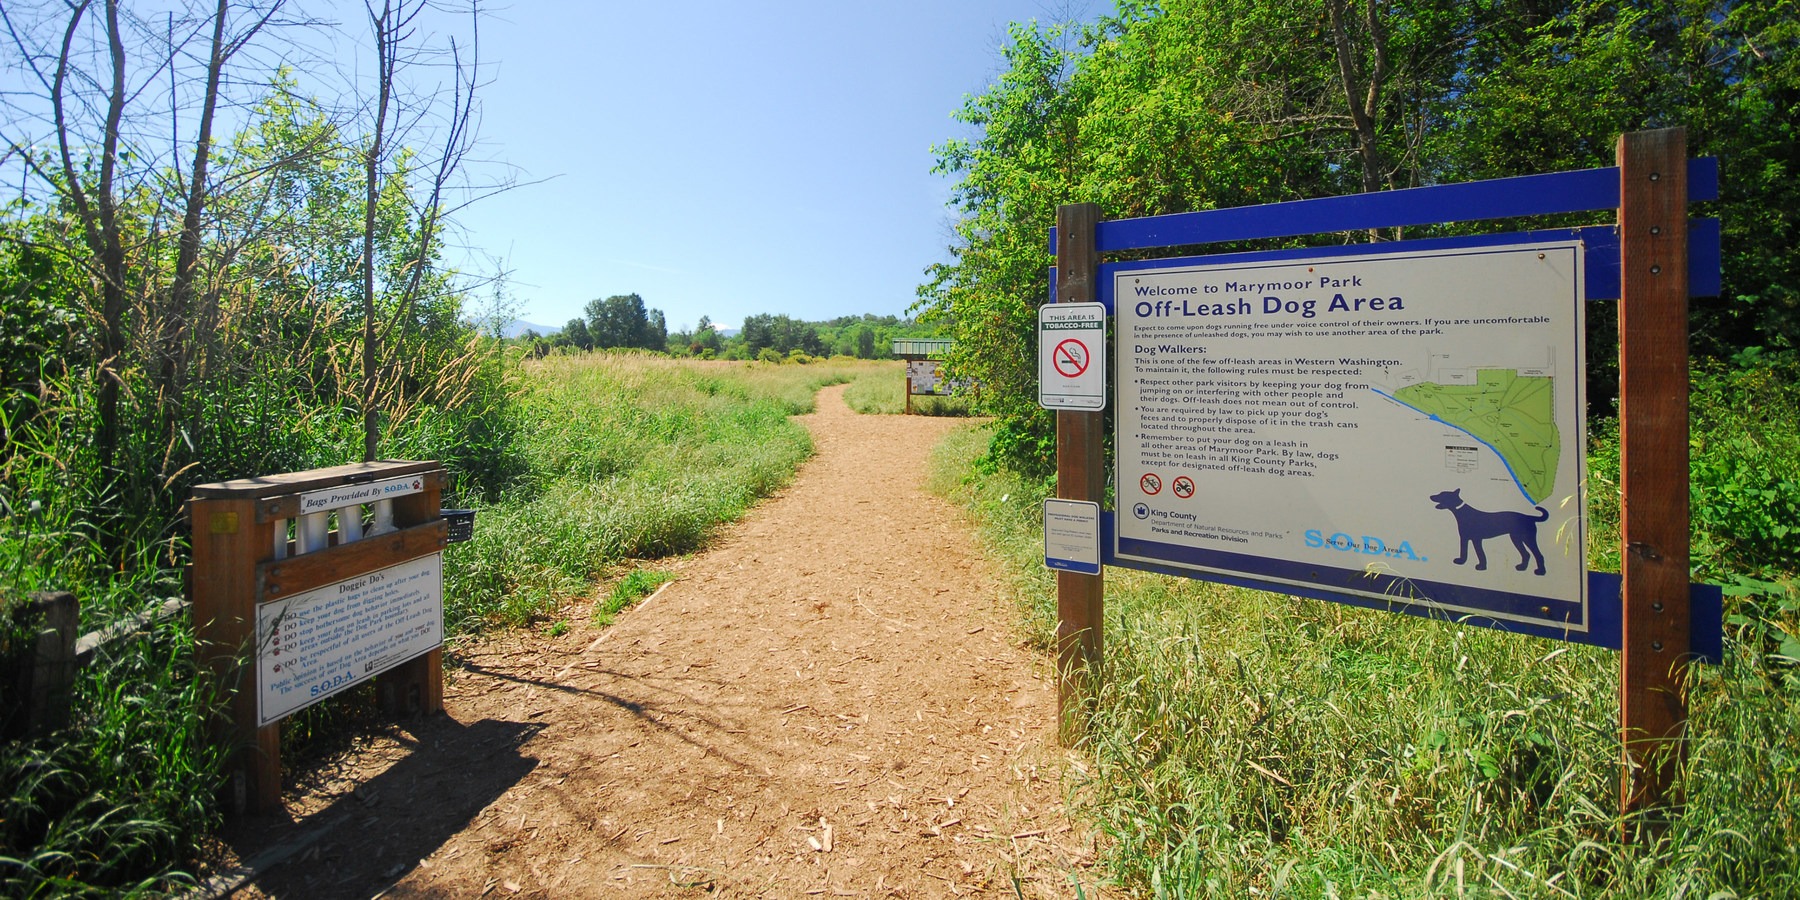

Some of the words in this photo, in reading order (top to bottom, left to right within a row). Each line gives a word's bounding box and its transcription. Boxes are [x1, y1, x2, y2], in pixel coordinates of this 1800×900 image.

[1134, 286, 1197, 296] Welcome
[1204, 283, 1218, 292] to
[1225, 281, 1312, 293] Marymoor
[1320, 275, 1361, 287] Park
[1135, 297, 1250, 317] Off-Leash
[1263, 296, 1316, 317] Dog
[1328, 294, 1404, 311] Area
[1134, 324, 1155, 332] Expect
[1205, 322, 1222, 331] dogs
[1224, 322, 1252, 330] running
[1473, 315, 1549, 324] uncomfortable
[1134, 344, 1156, 356] Dog
[1158, 344, 1206, 353] Walkers:
[1338, 358, 1402, 367] Washington.
[1207, 366, 1244, 375] following
[1311, 368, 1362, 376] respected:
[1140, 378, 1169, 387] Respect
[1196, 379, 1214, 388] park
[1249, 379, 1259, 389] by
[1262, 380, 1297, 390] keeping
[1324, 381, 1341, 391] dog
[1196, 389, 1239, 398] interfering
[1291, 390, 1322, 400] people
[1171, 406, 1204, 415] required
[1207, 407, 1216, 416] by
[1247, 408, 1264, 417] pick
[1304, 410, 1328, 419] dog's
[1170, 423, 1215, 433] throughout
[1141, 432, 1183, 441] Remember
[1196, 436, 1210, 445] put
[1234, 437, 1249, 447] dog
[1208, 445, 1253, 455] Marymoor
[1256, 448, 1278, 456] Park.
[1282, 449, 1293, 458] By
[1296, 450, 1314, 459] law,
[1316, 451, 1338, 461] dogs
[1141, 460, 1166, 468] except
[1182, 460, 1225, 471] designated
[1228, 464, 1265, 473] off-leash
[1268, 467, 1284, 477] dog
[306, 499, 328, 507] Bags
[330, 490, 369, 503] Provided
[372, 488, 381, 496] By
[384, 483, 410, 493] S.O.D.A.
[1150, 509, 1167, 519] King
[1169, 511, 1196, 522] County
[1151, 518, 1184, 528] Department
[1194, 523, 1216, 531] Natural
[1217, 525, 1249, 535] Resources
[1151, 526, 1169, 534] Parks
[1183, 530, 1218, 540] Recreation
[1220, 534, 1248, 543] Division
[1304, 529, 1428, 562] S.O.D.A.
[340, 579, 366, 593] Doggie
[370, 573, 384, 584] Do's
